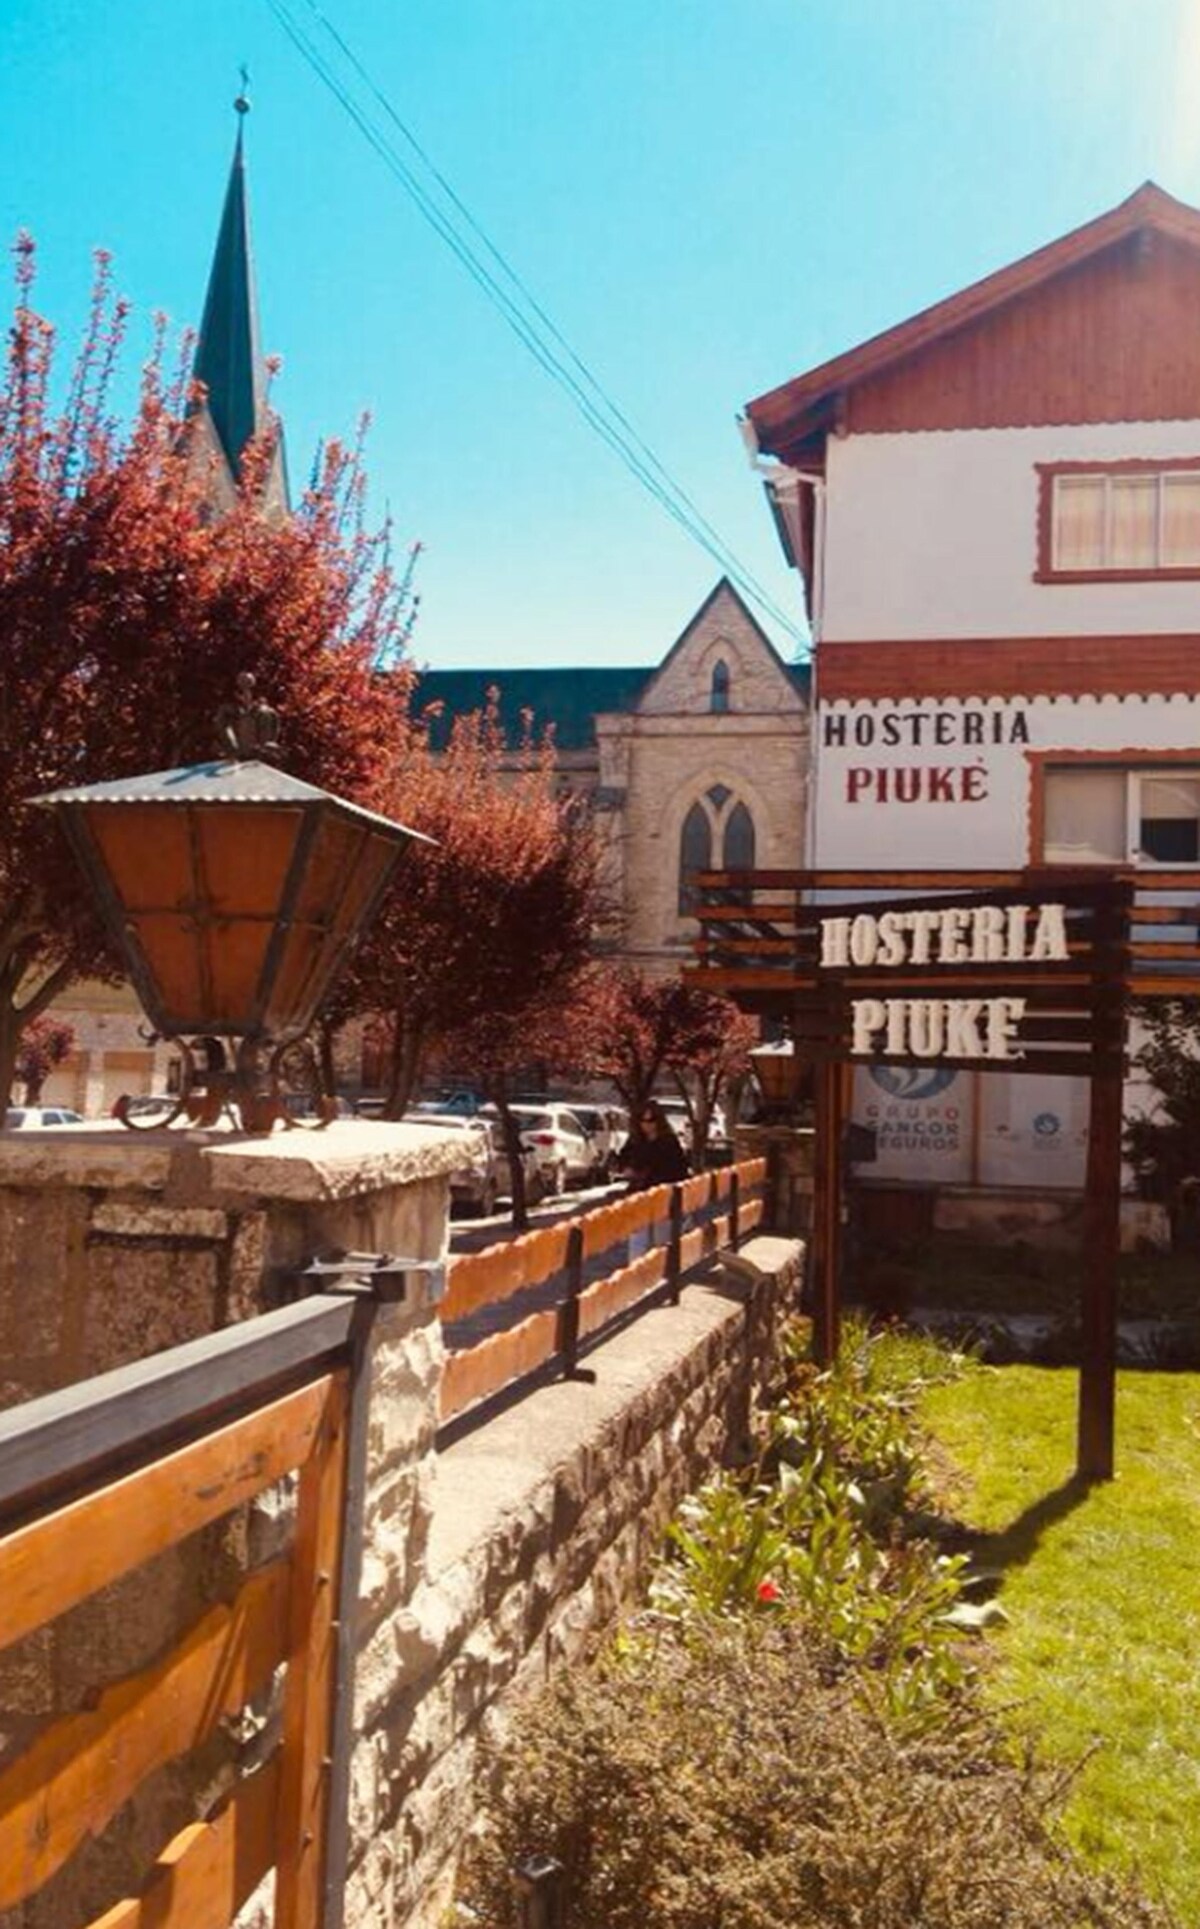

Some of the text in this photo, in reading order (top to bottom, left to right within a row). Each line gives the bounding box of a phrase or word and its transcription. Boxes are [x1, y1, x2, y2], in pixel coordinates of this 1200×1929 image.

[824, 711, 1030, 747] HOSTERIA
[819, 903, 1070, 967] HOSTERIA
[850, 997, 1027, 1059] PIUKE
[866, 1104, 959, 1120] GRUPO
[879, 1136, 959, 1151] EGUROS
